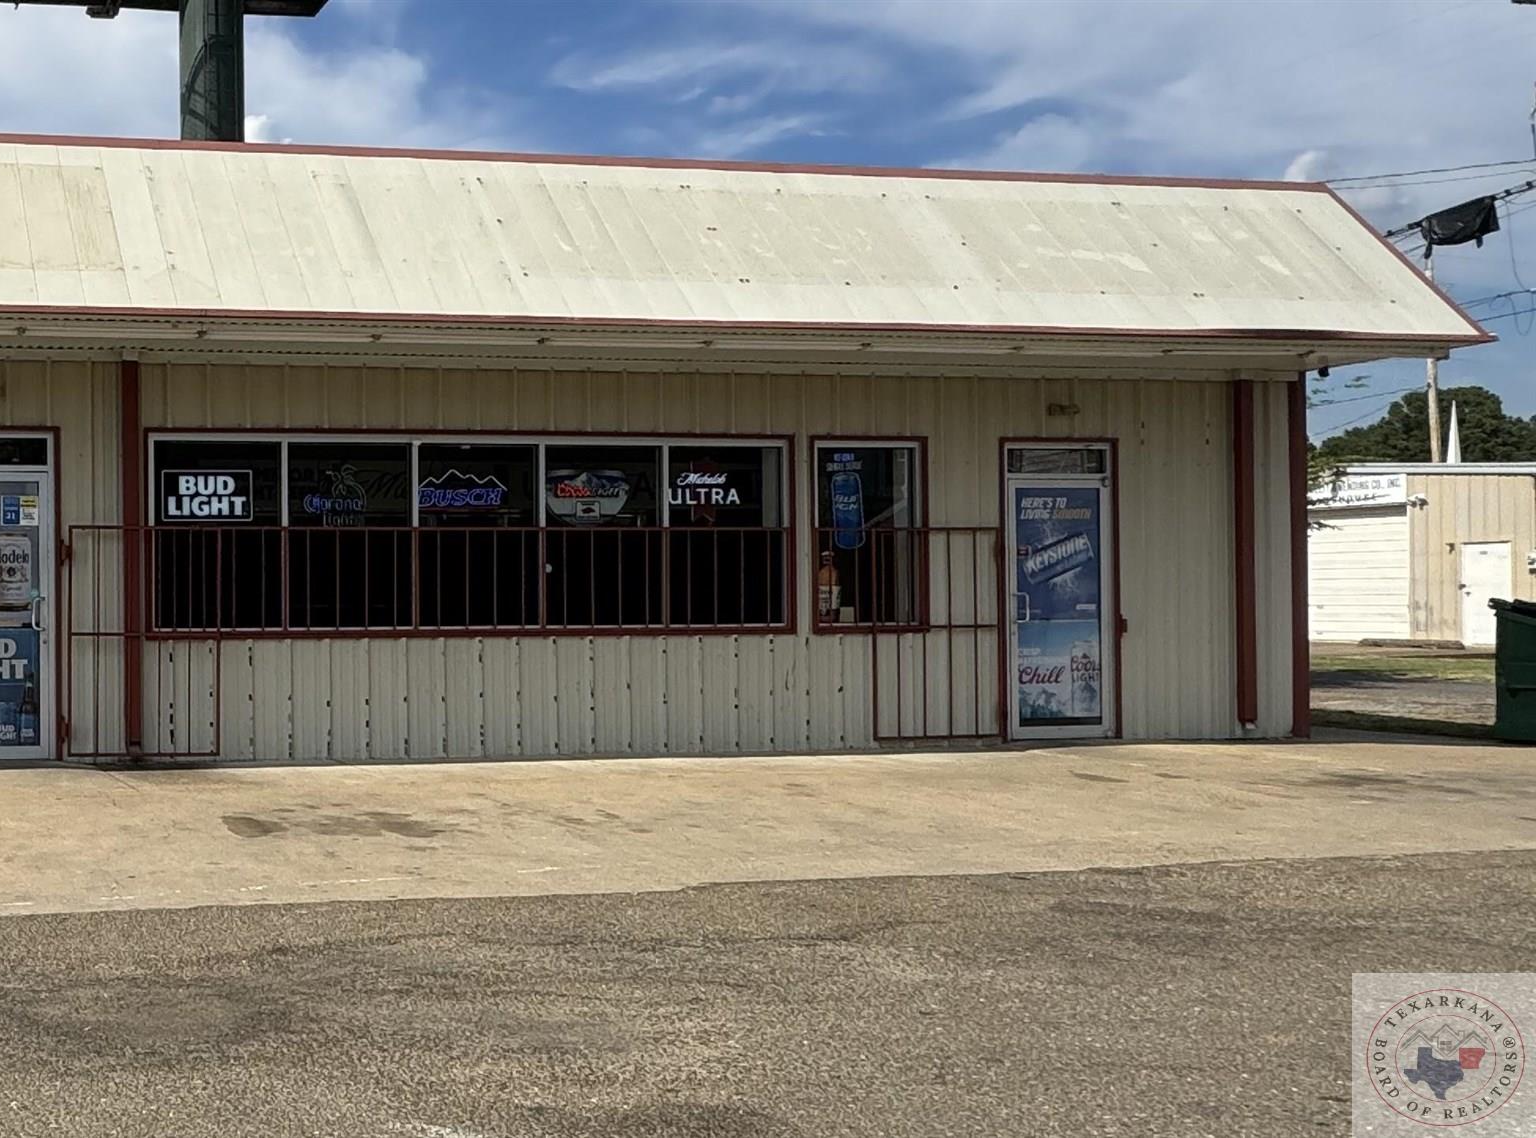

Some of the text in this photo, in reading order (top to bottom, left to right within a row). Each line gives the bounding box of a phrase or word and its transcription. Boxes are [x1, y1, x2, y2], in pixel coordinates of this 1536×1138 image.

[178, 475, 236, 495] BUD
[676, 471, 728, 485] Michelob
[167, 496, 248, 516] LIGHT
[303, 493, 362, 514] Corona
[416, 487, 504, 507] BUSCH
[668, 488, 741, 505] ULTRA
[1021, 497, 1067, 509] HERE'S TO
[1018, 664, 1066, 685] Chill
